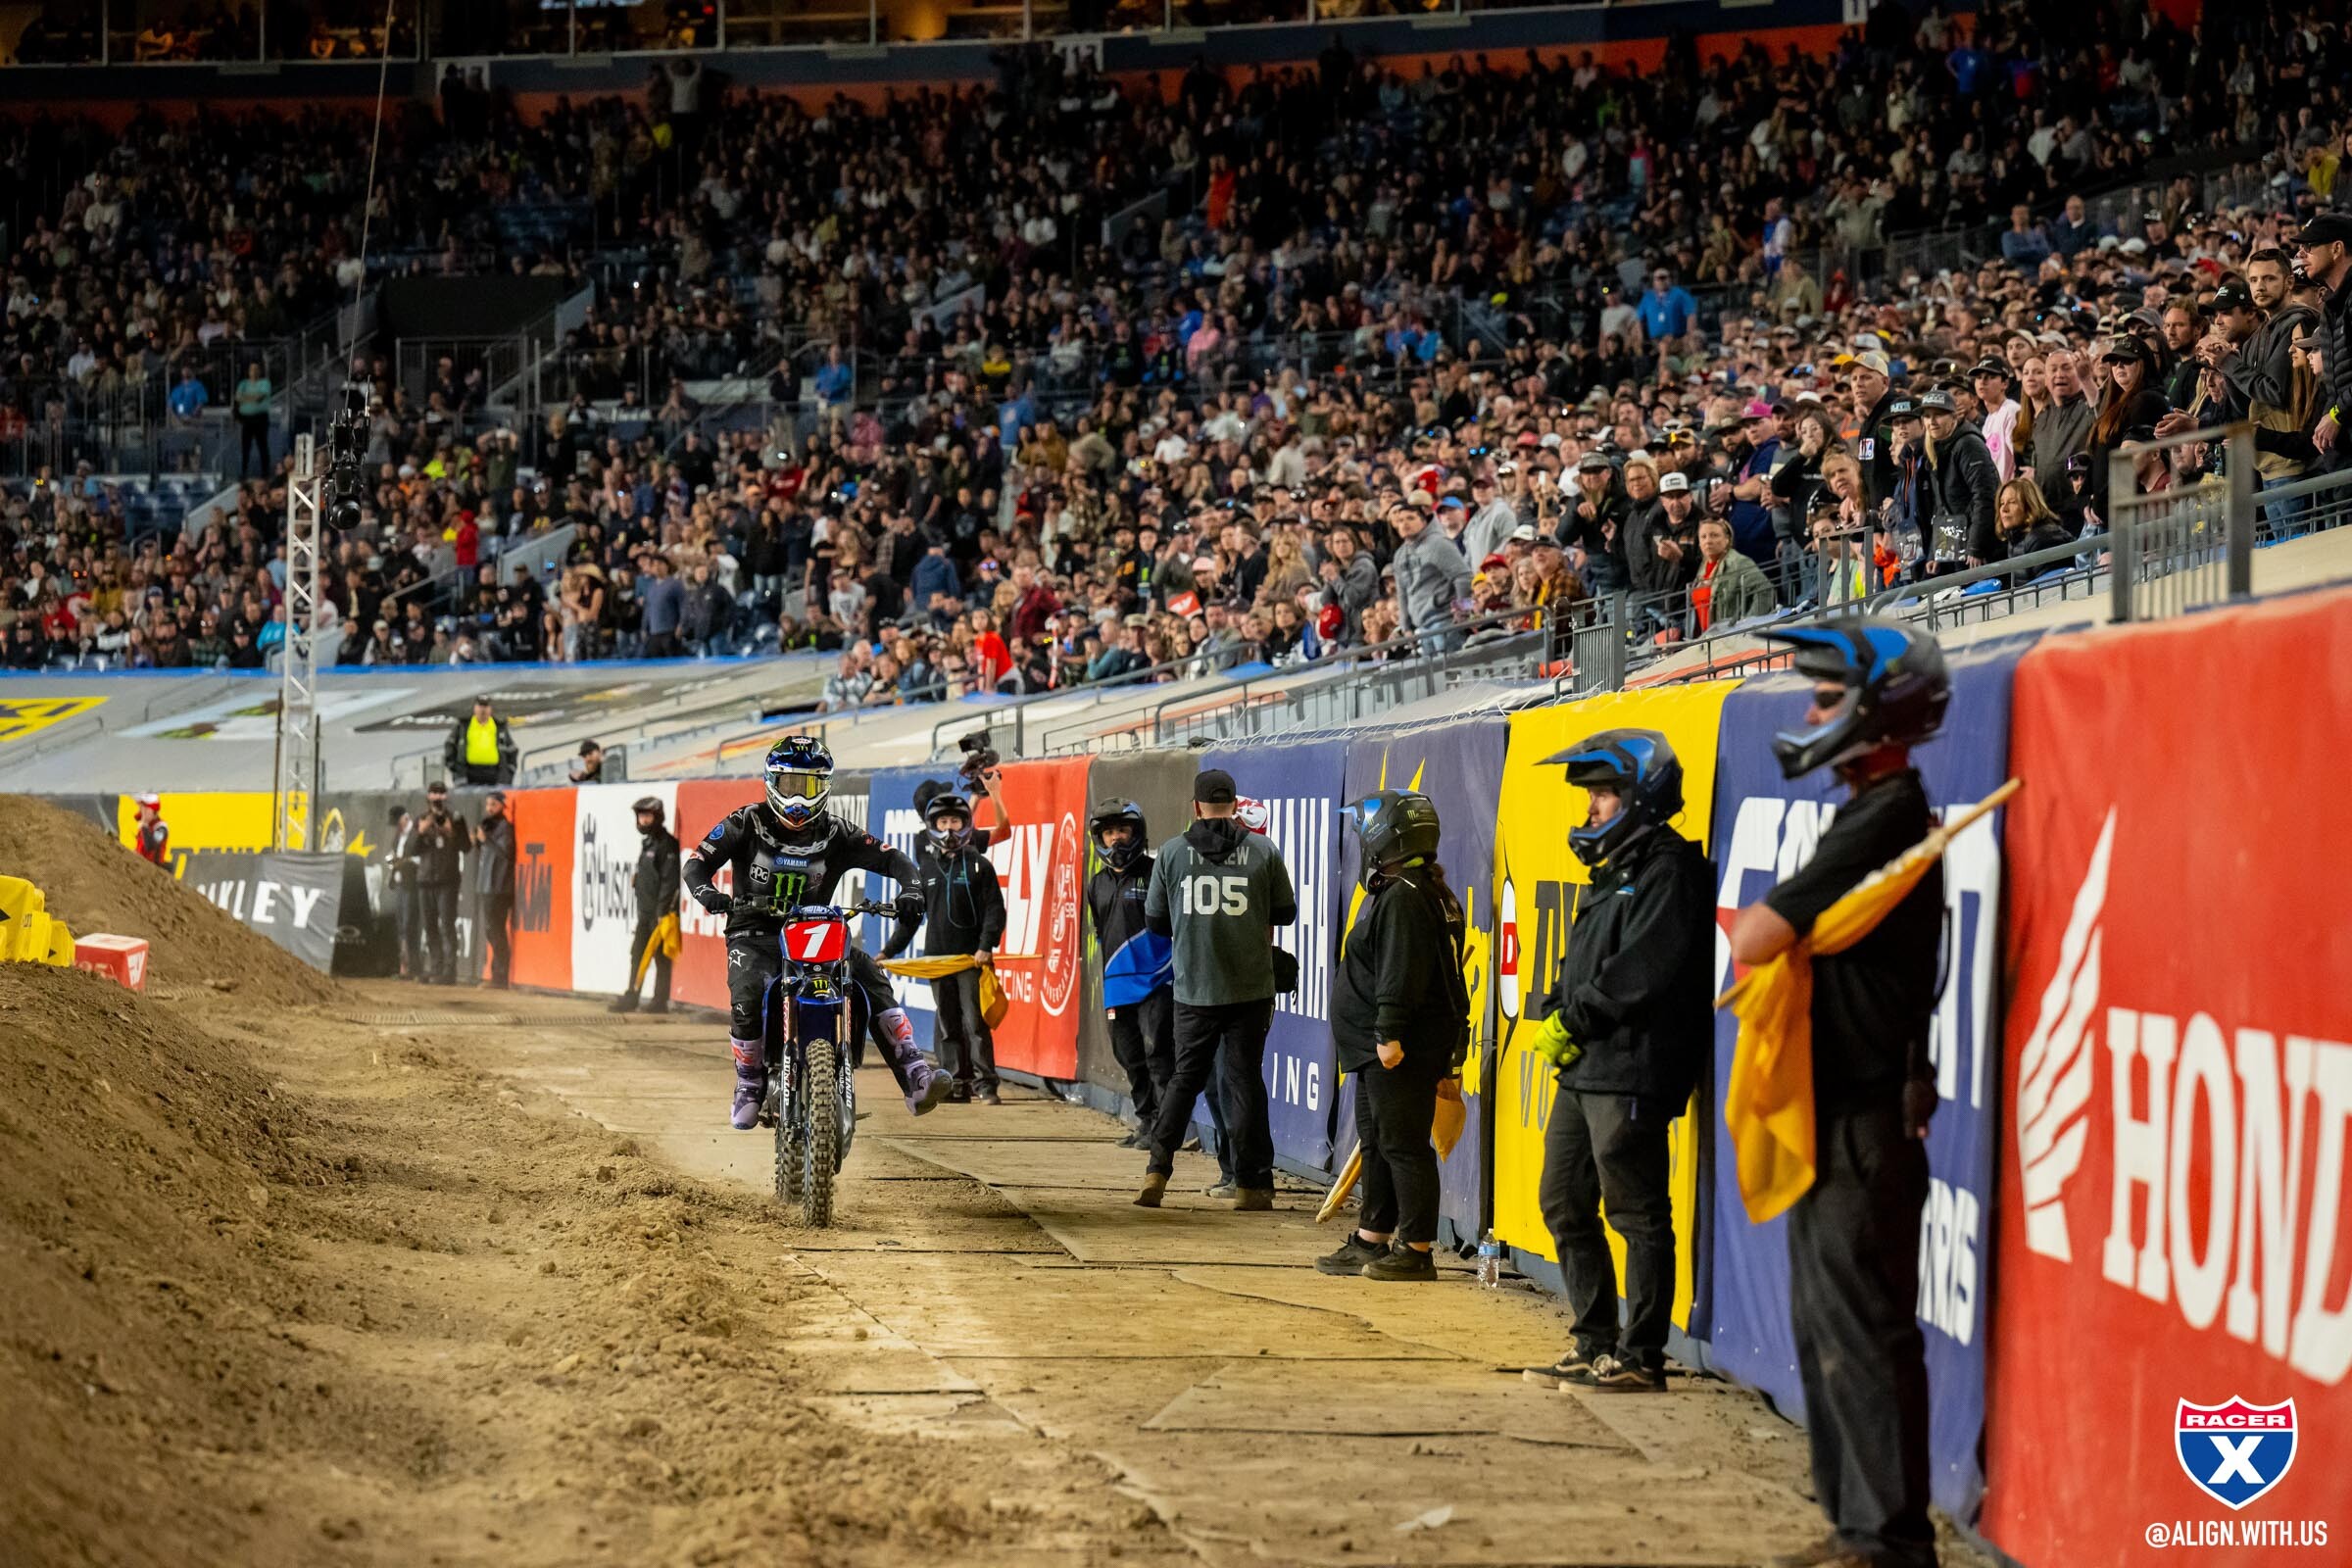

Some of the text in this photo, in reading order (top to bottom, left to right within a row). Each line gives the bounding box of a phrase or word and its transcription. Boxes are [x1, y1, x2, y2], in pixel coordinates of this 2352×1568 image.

[751, 865, 768, 881] PPG
[783, 858, 808, 868] YAMAHA
[1180, 875, 1249, 916] 105
[801, 923, 832, 959] 1
